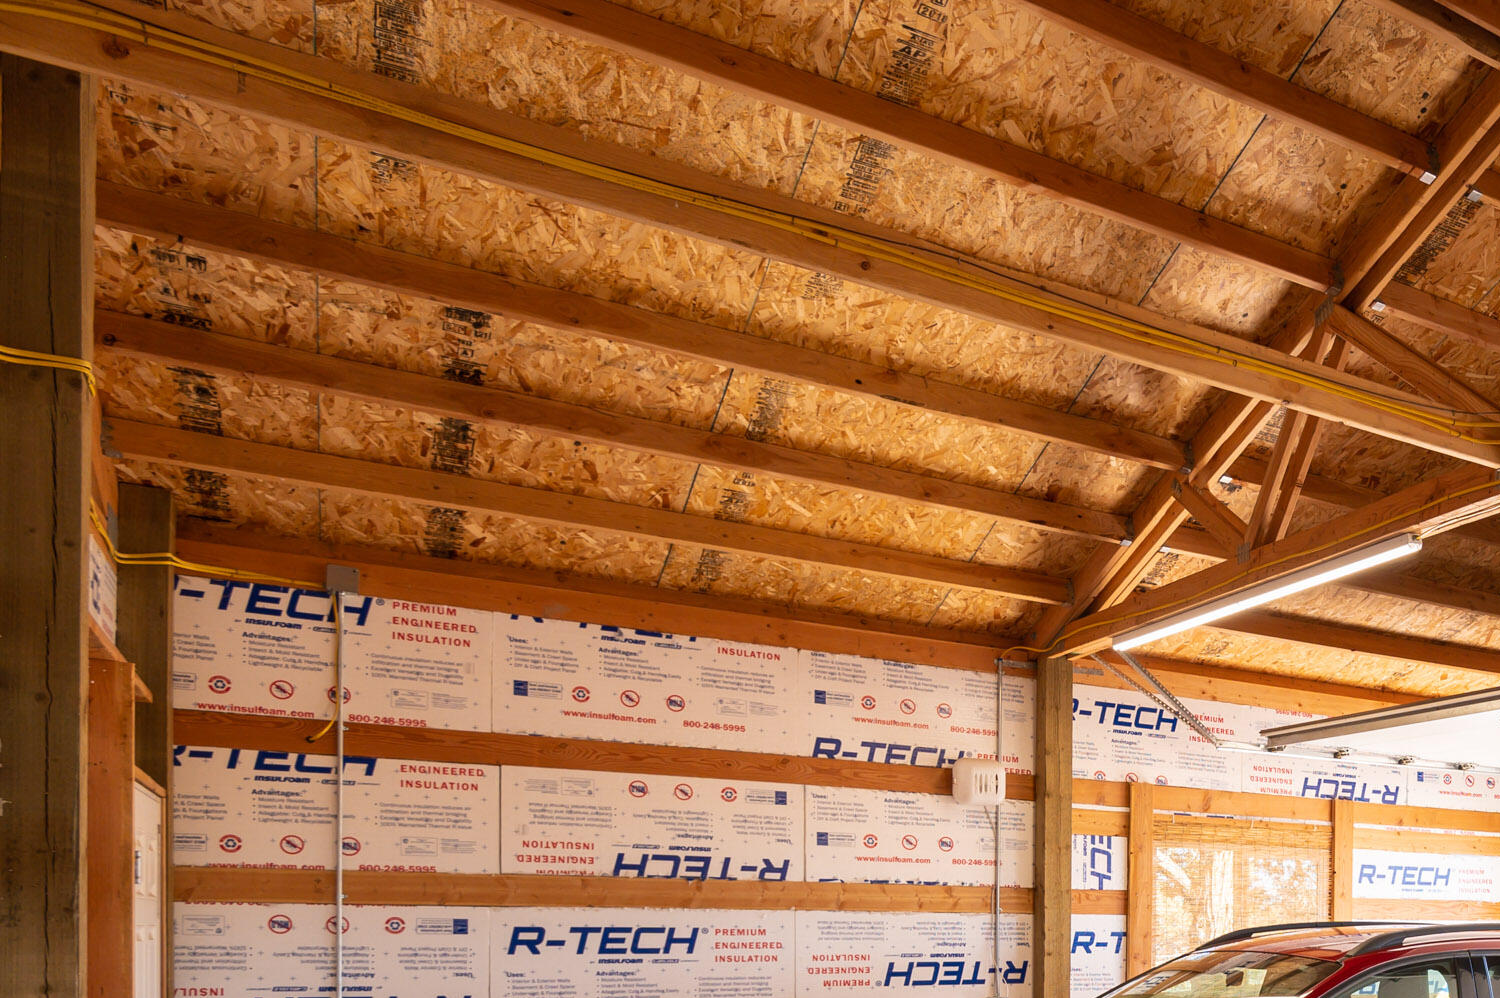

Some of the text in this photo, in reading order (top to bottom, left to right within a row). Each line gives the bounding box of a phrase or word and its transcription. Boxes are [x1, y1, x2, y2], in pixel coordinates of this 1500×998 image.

[174, 574, 373, 627] -TECH
[392, 601, 458, 617] PREMIUM
[392, 616, 478, 634] ENGINEERED
[392, 632, 472, 648] INSULATION
[717, 647, 781, 662] INSULATION
[197, 702, 315, 719] www.insulfoam.com
[563, 710, 657, 725] www.insulfoam.com
[349, 713, 428, 728] 800-248-5995
[854, 717, 930, 730] www.insulfoam.com
[812, 737, 965, 769] R-TECH
[400, 764, 485, 777] ENGINEERED
[1253, 764, 1293, 774] INSULATION
[400, 779, 479, 791] INSULATION
[1250, 776, 1293, 785] ENGINEERED
[1300, 776, 1400, 806] R-TECH
[522, 839, 595, 850] INSULATION
[516, 855, 595, 865] ENGINEERED
[856, 855, 931, 864] www.insulfoam.com
[613, 852, 790, 882] R-TECH
[1358, 864, 1451, 887] R-TECH
[714, 928, 767, 936] PREMIUM
[507, 926, 700, 955] R-TECH
[714, 941, 783, 950] ENGINEERED
[714, 954, 779, 963] INSULATION
[812, 954, 871, 962] INSULATION
[807, 966, 871, 975] ENGINEERED
[883, 960, 1029, 987] R-TECH
[823, 979, 871, 987] PREMIUM
